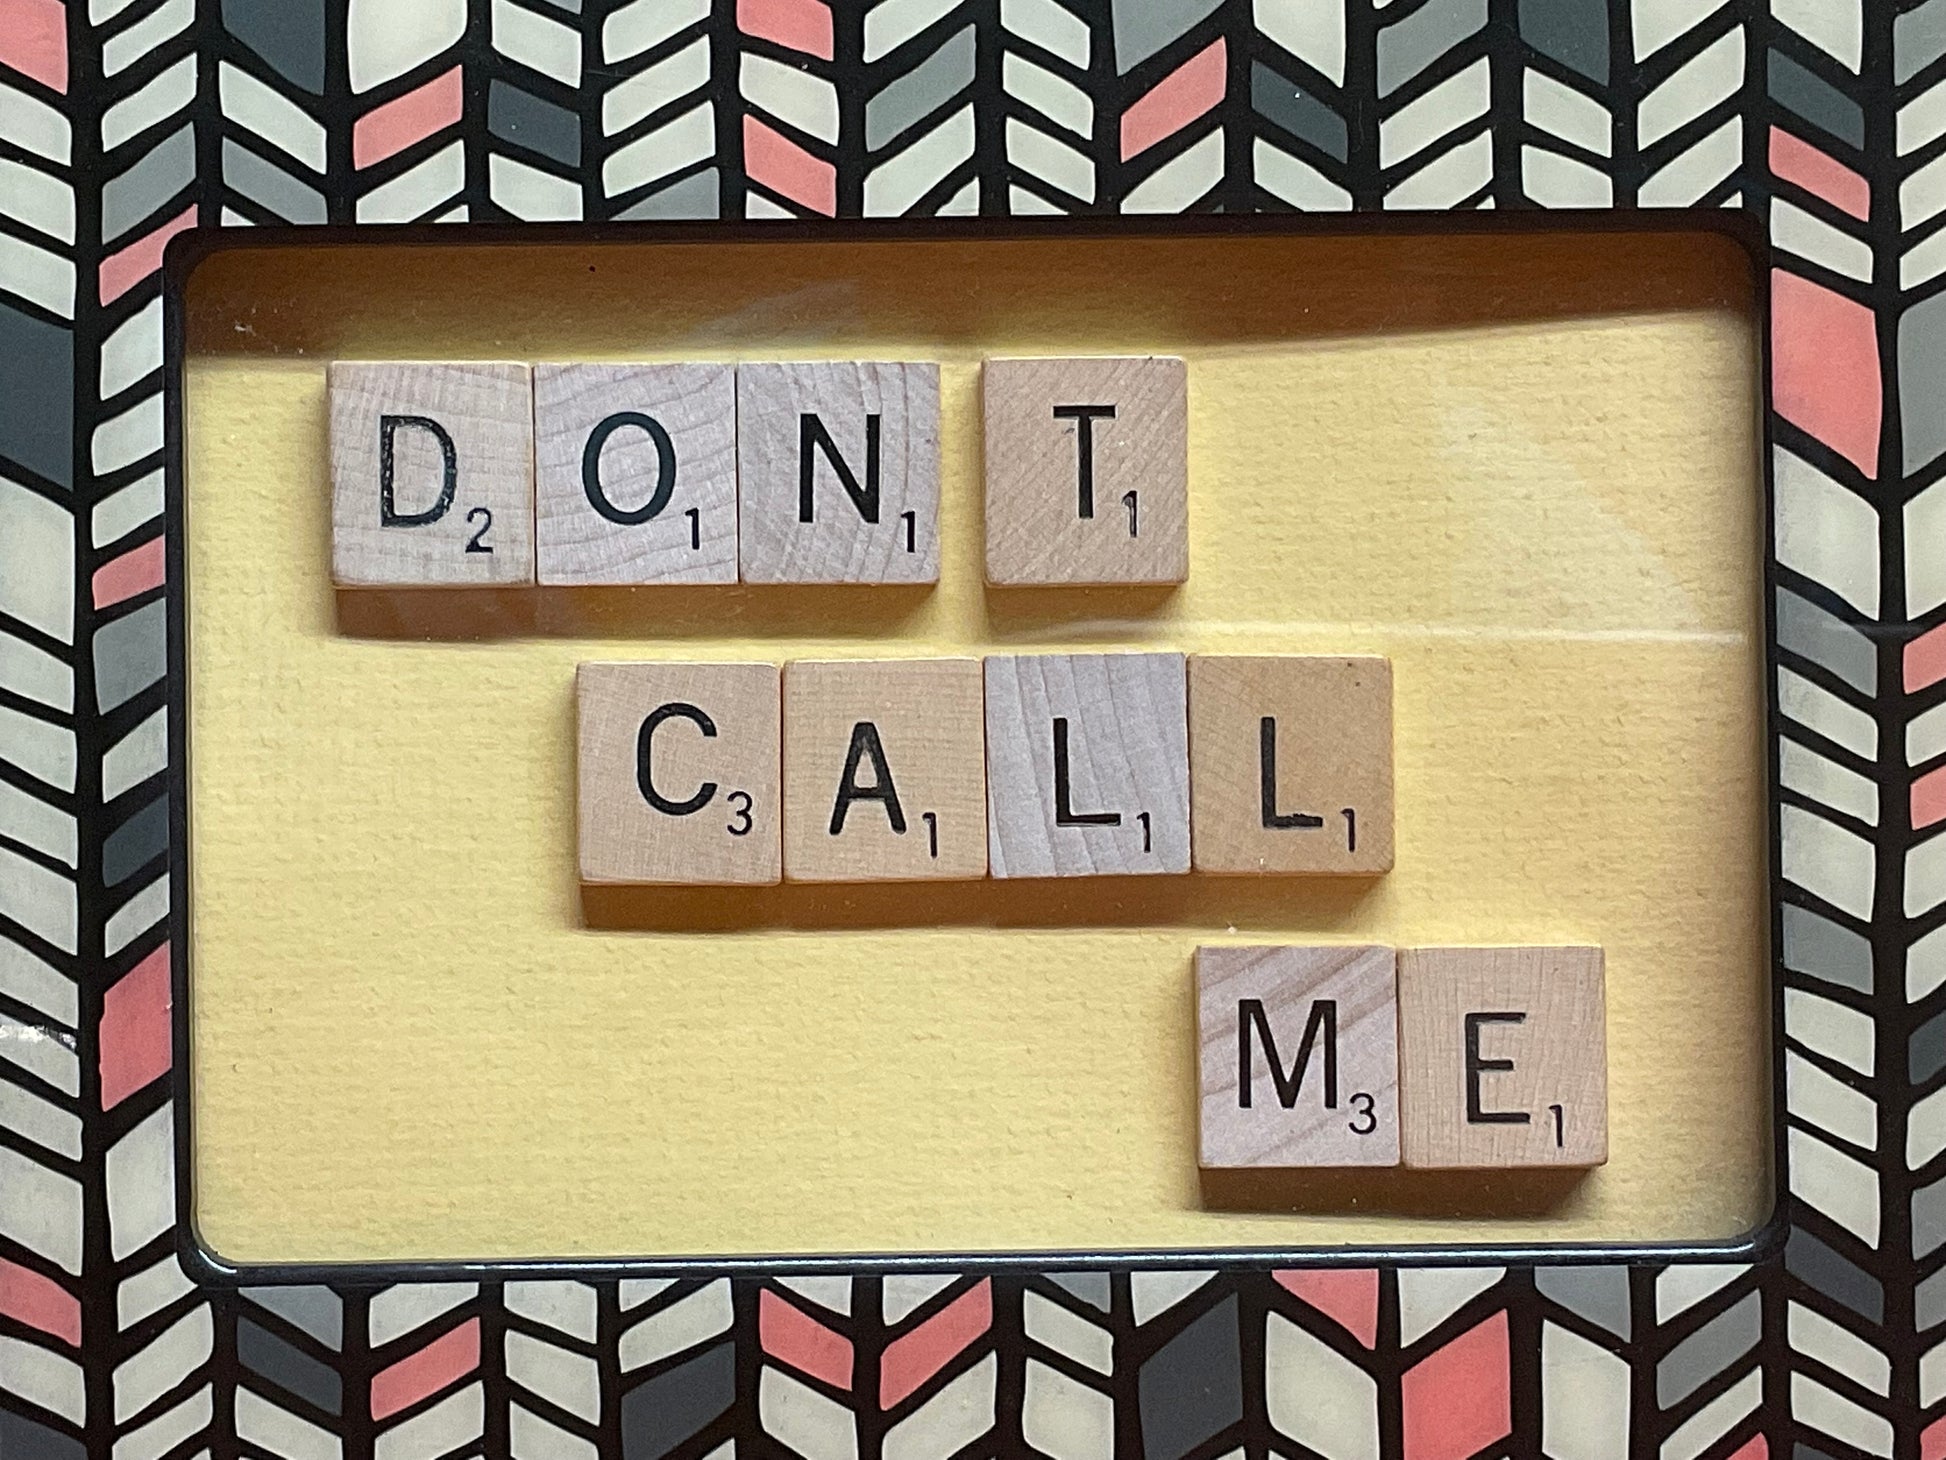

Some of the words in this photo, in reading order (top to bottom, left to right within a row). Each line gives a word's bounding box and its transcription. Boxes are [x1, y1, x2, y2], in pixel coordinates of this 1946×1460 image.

[464, 506, 495, 555] 2
[683, 506, 701, 551] 1
[899, 509, 917, 554] 1
[1121, 489, 1139, 539] 1
[635, 701, 1325, 837] CALL
[726, 789, 754, 837] 3
[921, 811, 939, 859] 1
[1135, 810, 1152, 854] 1
[1339, 807, 1357, 854] 1
[1237, 998, 1532, 1126] ME
[1347, 1091, 1378, 1136] 3
[1547, 1103, 1564, 1149] 1
